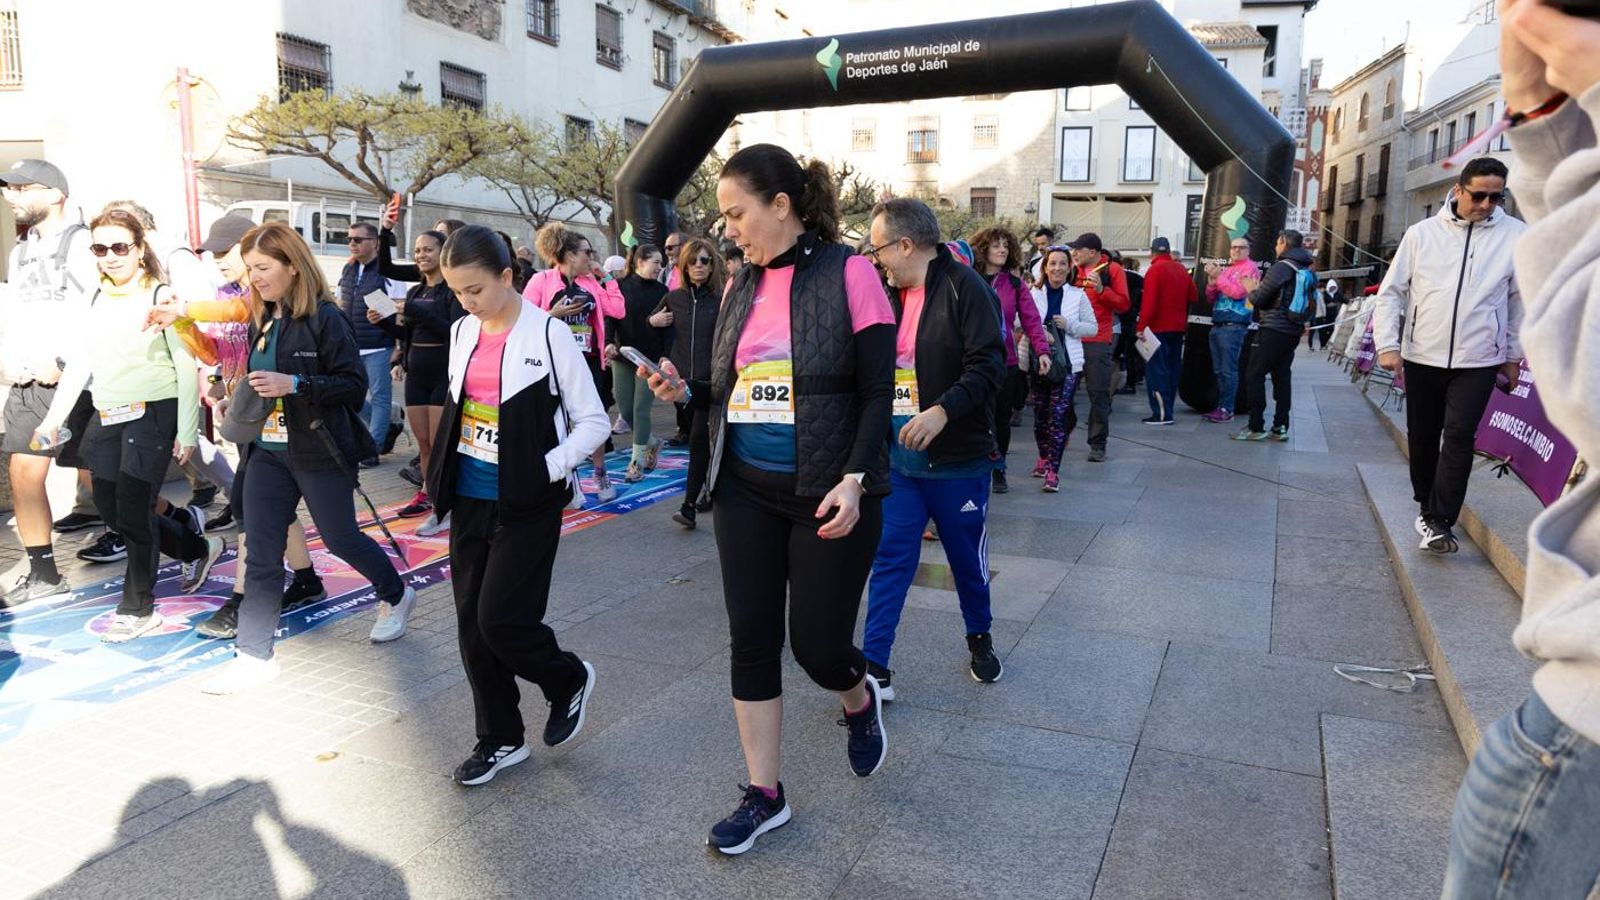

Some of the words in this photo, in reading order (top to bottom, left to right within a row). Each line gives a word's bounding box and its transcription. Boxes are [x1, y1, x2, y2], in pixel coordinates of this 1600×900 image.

[846, 47, 901, 65] Patronato
[904, 41, 961, 60] Municipal
[963, 39, 980, 51] de
[846, 62, 902, 80] Deportes
[904, 61, 917, 73] de
[919, 57, 948, 73] Jaén
[525, 358, 543, 367] FILA
[751, 384, 790, 402] 892
[893, 387, 911, 400] 94
[475, 425, 498, 445] 712
[1489, 411, 1555, 463] #SOMOSELCAMBIO
